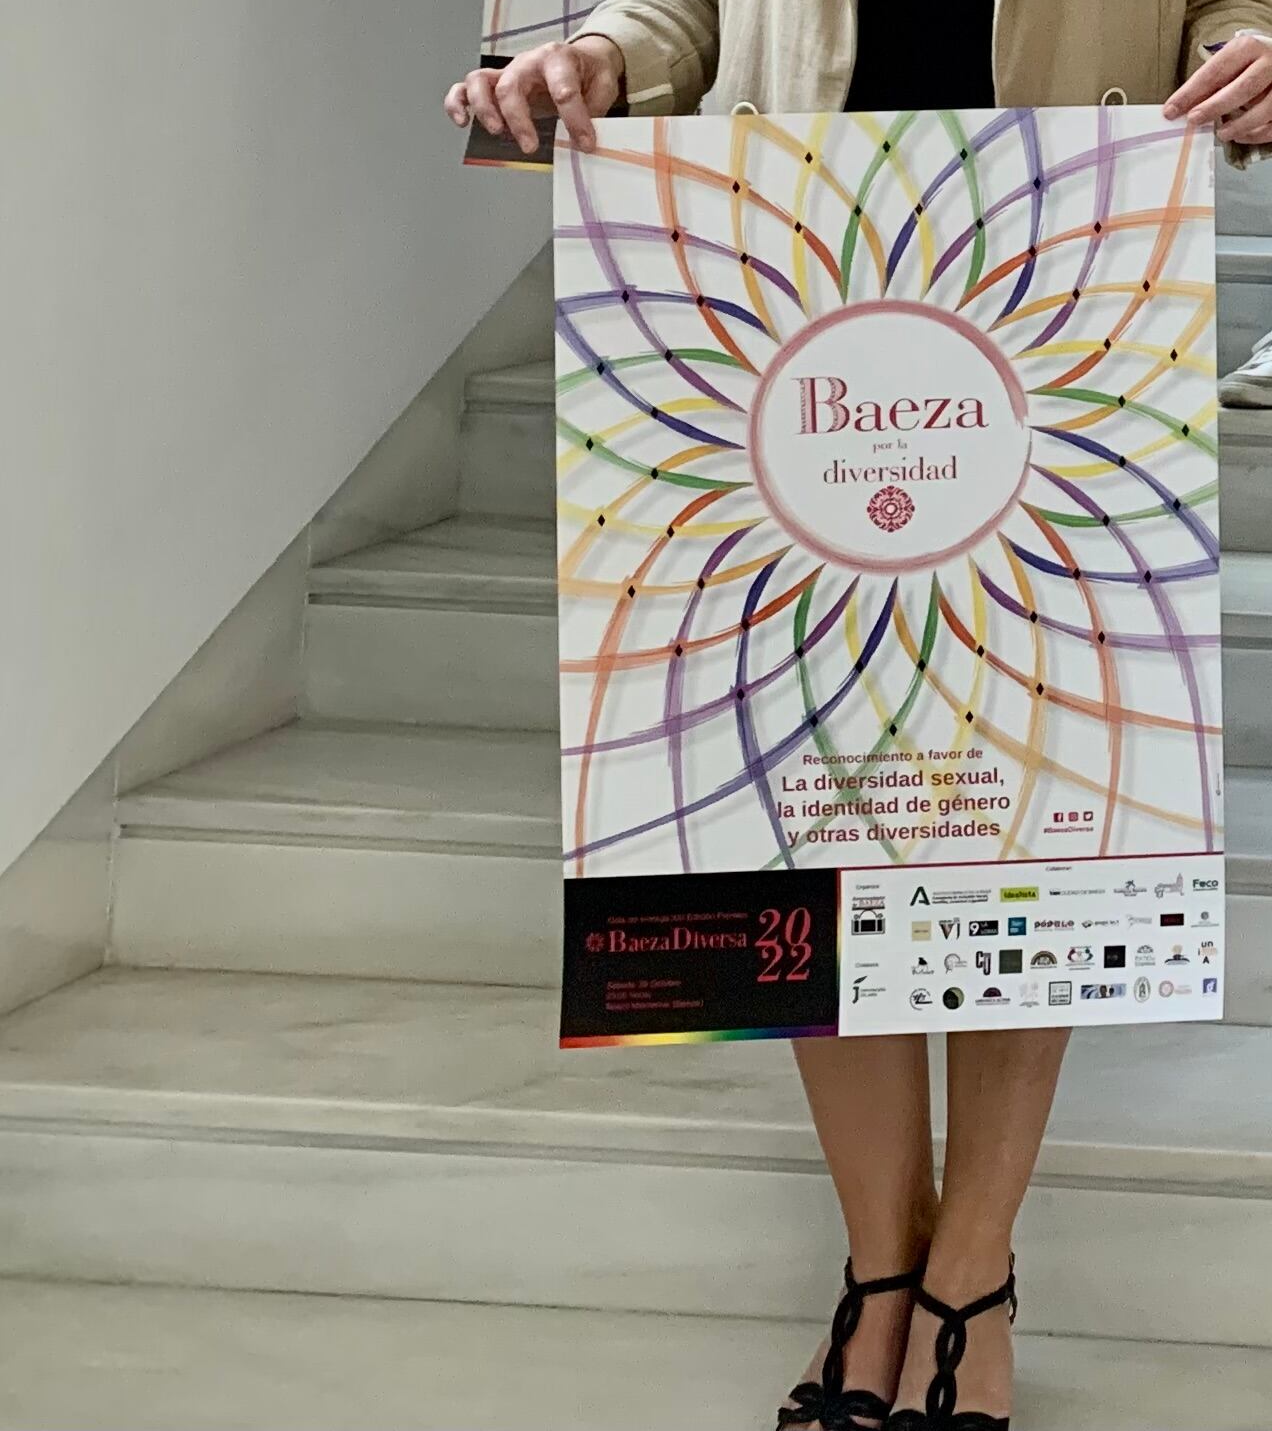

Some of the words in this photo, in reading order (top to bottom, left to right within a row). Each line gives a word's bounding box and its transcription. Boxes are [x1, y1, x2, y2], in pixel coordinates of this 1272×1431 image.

[792, 376, 989, 435] Baeza
[873, 441, 893, 454] por
[897, 439, 907, 450] la
[824, 455, 958, 484] diversidad
[803, 750, 912, 766] Reconocimiento
[916, 752, 924, 762] a
[928, 748, 964, 762] favor
[967, 748, 983, 760] de
[782, 775, 808, 793] La
[814, 769, 924, 791] diversidad
[931, 767, 1005, 787] sexual,
[777, 801, 795, 819] la
[802, 797, 899, 818] identidad
[906, 795, 931, 813] de
[938, 793, 1011, 816] género
[787, 829, 799, 848] y
[806, 825, 861, 844] otras
[866, 820, 1001, 842] diversidades
[1192, 878, 1220, 889] Feco
[608, 926, 748, 953] BaezaDiversa
[755, 907, 811, 947] 20
[757, 942, 812, 982] 22
